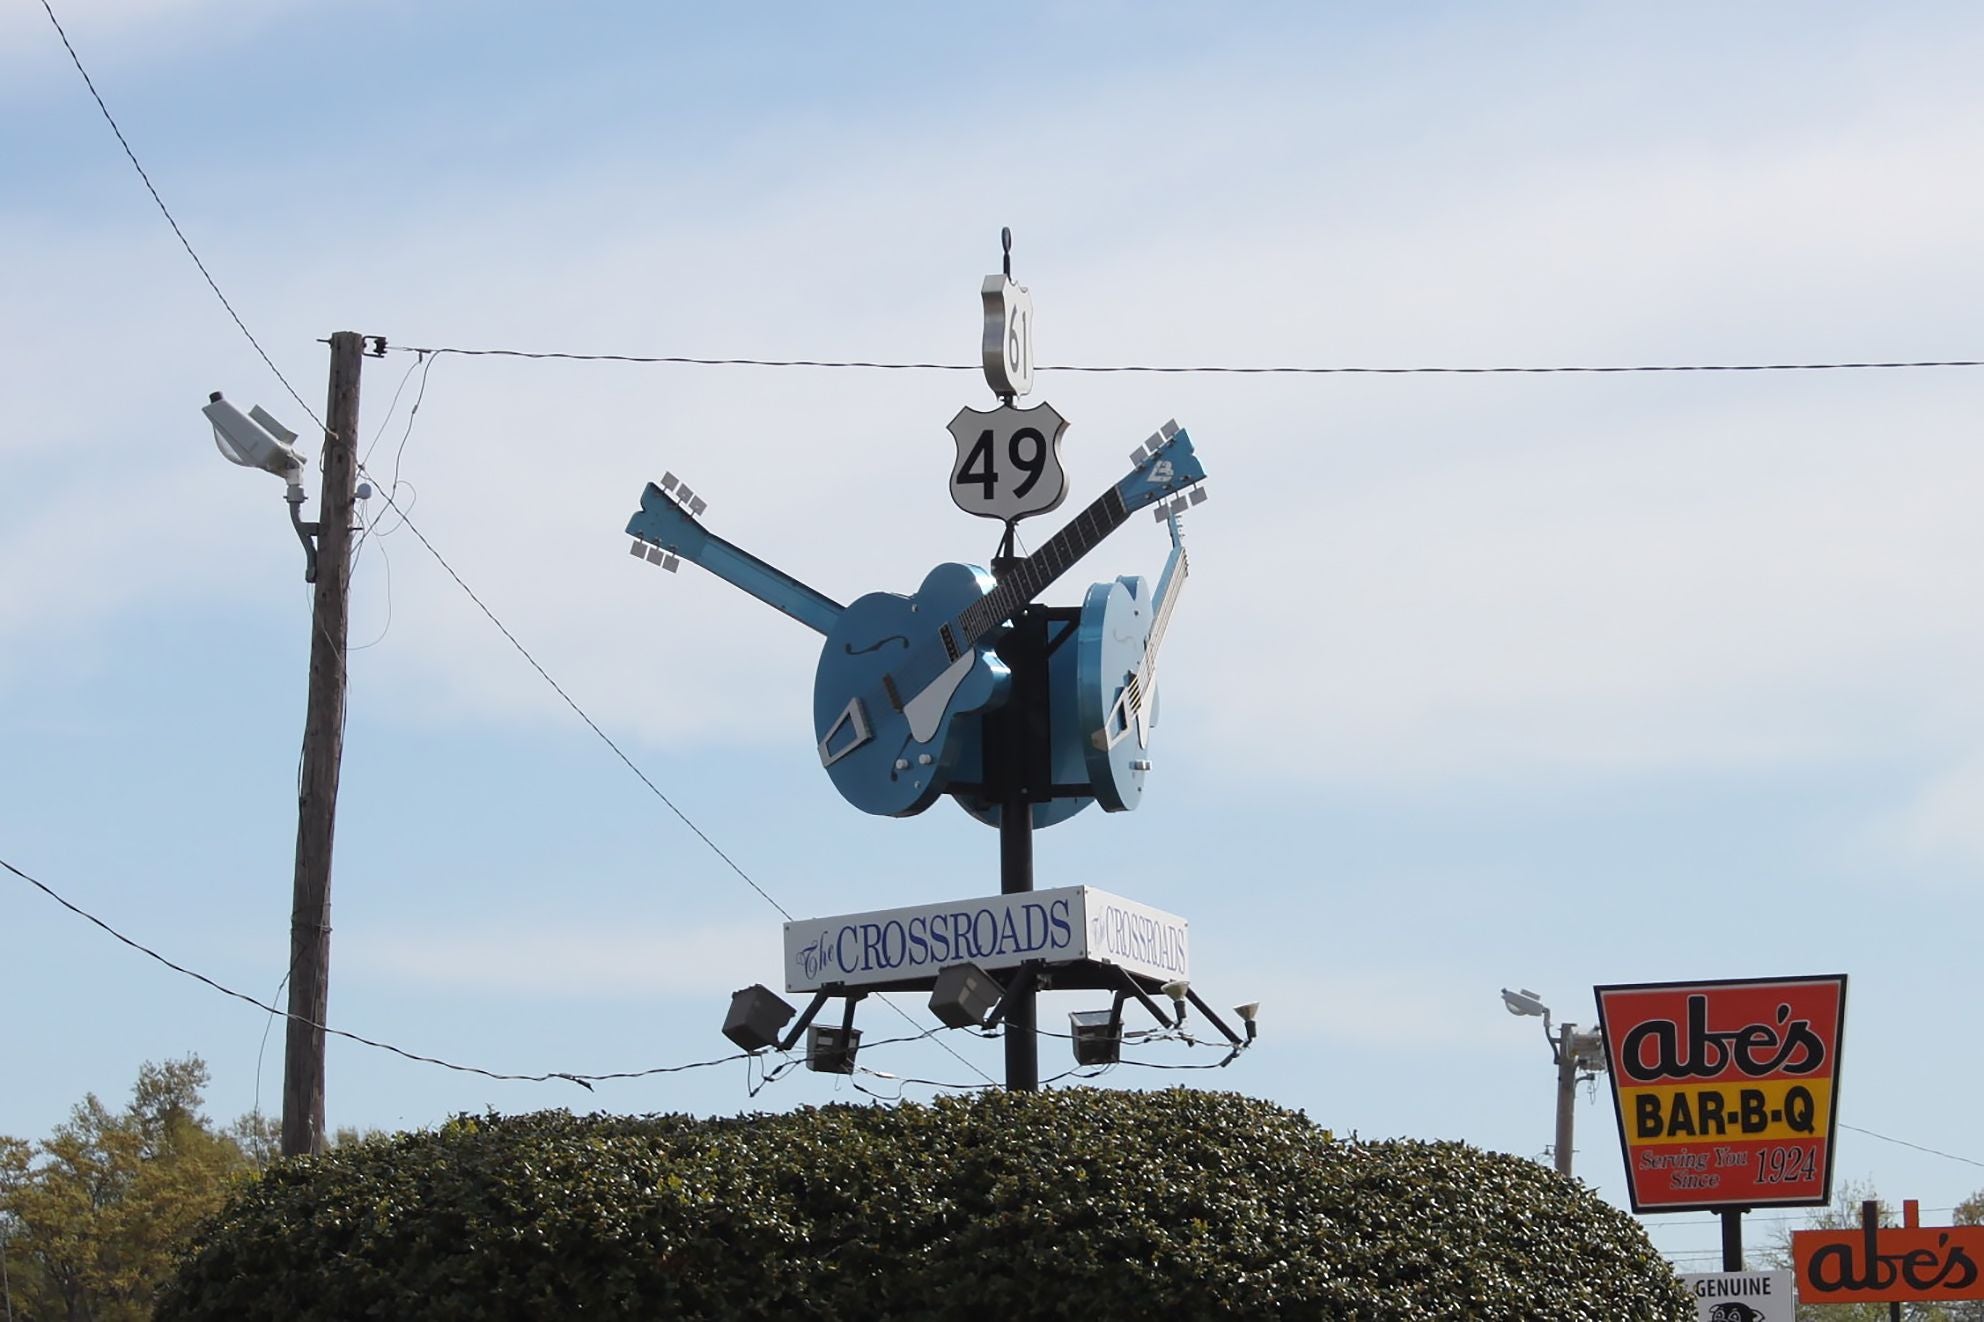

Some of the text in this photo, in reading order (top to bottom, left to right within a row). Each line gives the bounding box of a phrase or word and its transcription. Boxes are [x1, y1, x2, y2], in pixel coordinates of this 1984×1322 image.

[1009, 304, 1028, 380] 61
[956, 427, 1047, 500] 49
[796, 899, 1072, 980] The CROSSROADS
[1105, 905, 1186, 975] CROSSROADS
[1621, 995, 1825, 1080] abe's
[1635, 1085, 1815, 1139] BAR-B-Q
[1639, 1146, 1748, 1171] Serving You
[1669, 1171, 1720, 1190] Since
[1754, 1146, 1817, 1185] 1924
[1808, 1201, 1978, 1292] abe's
[1696, 1277, 1771, 1297] GENUINE
